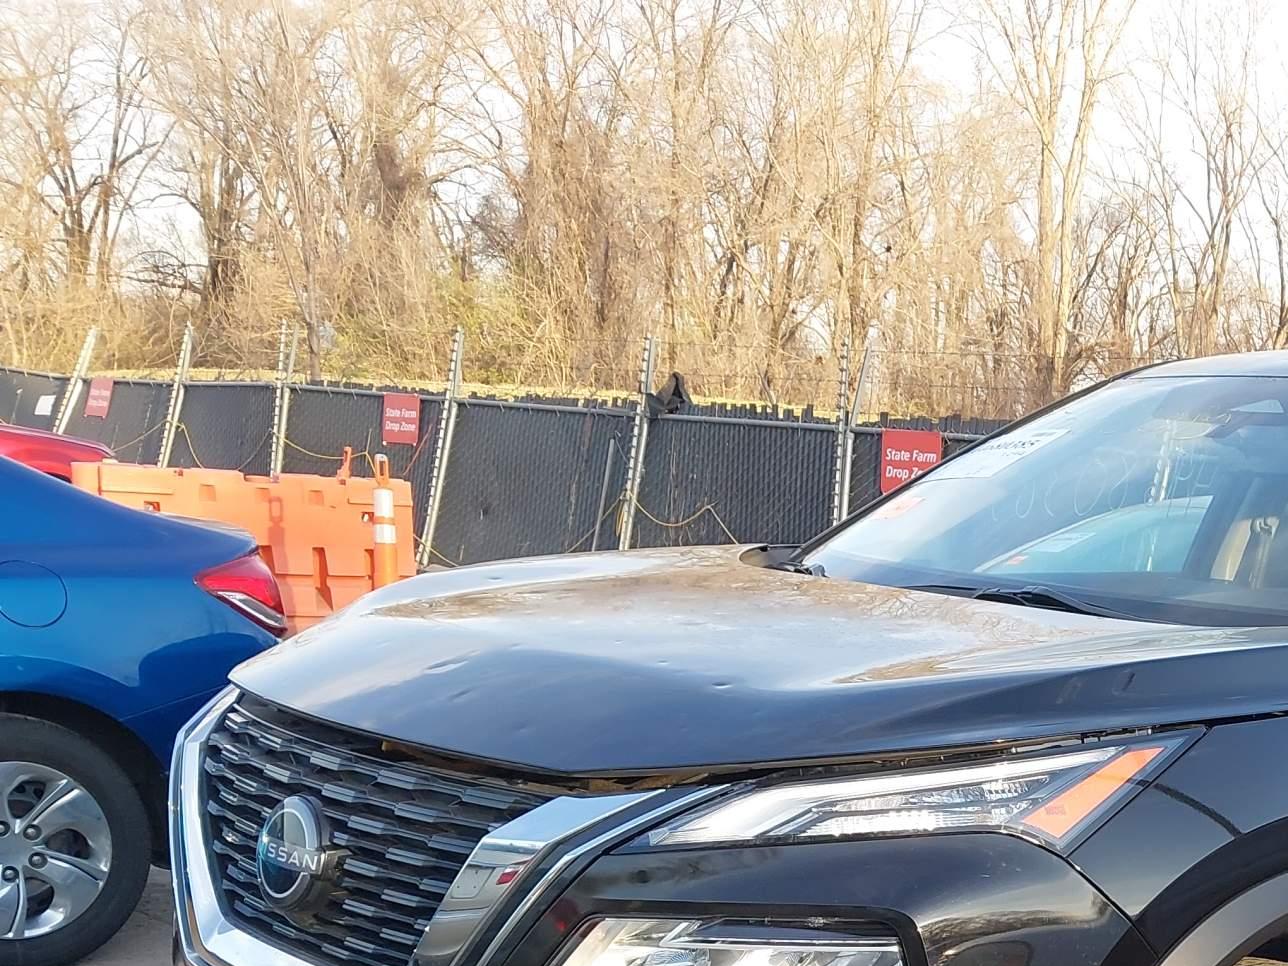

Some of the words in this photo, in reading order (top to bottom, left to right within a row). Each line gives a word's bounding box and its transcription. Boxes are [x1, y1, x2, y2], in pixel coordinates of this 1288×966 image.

[385, 407, 400, 417] State
[401, 409, 417, 418] Farm
[385, 421, 400, 432] Drop
[400, 422, 416, 432] Zone
[885, 448, 910, 461] State
[912, 450, 937, 463] Farm
[885, 465, 909, 481] Drop
